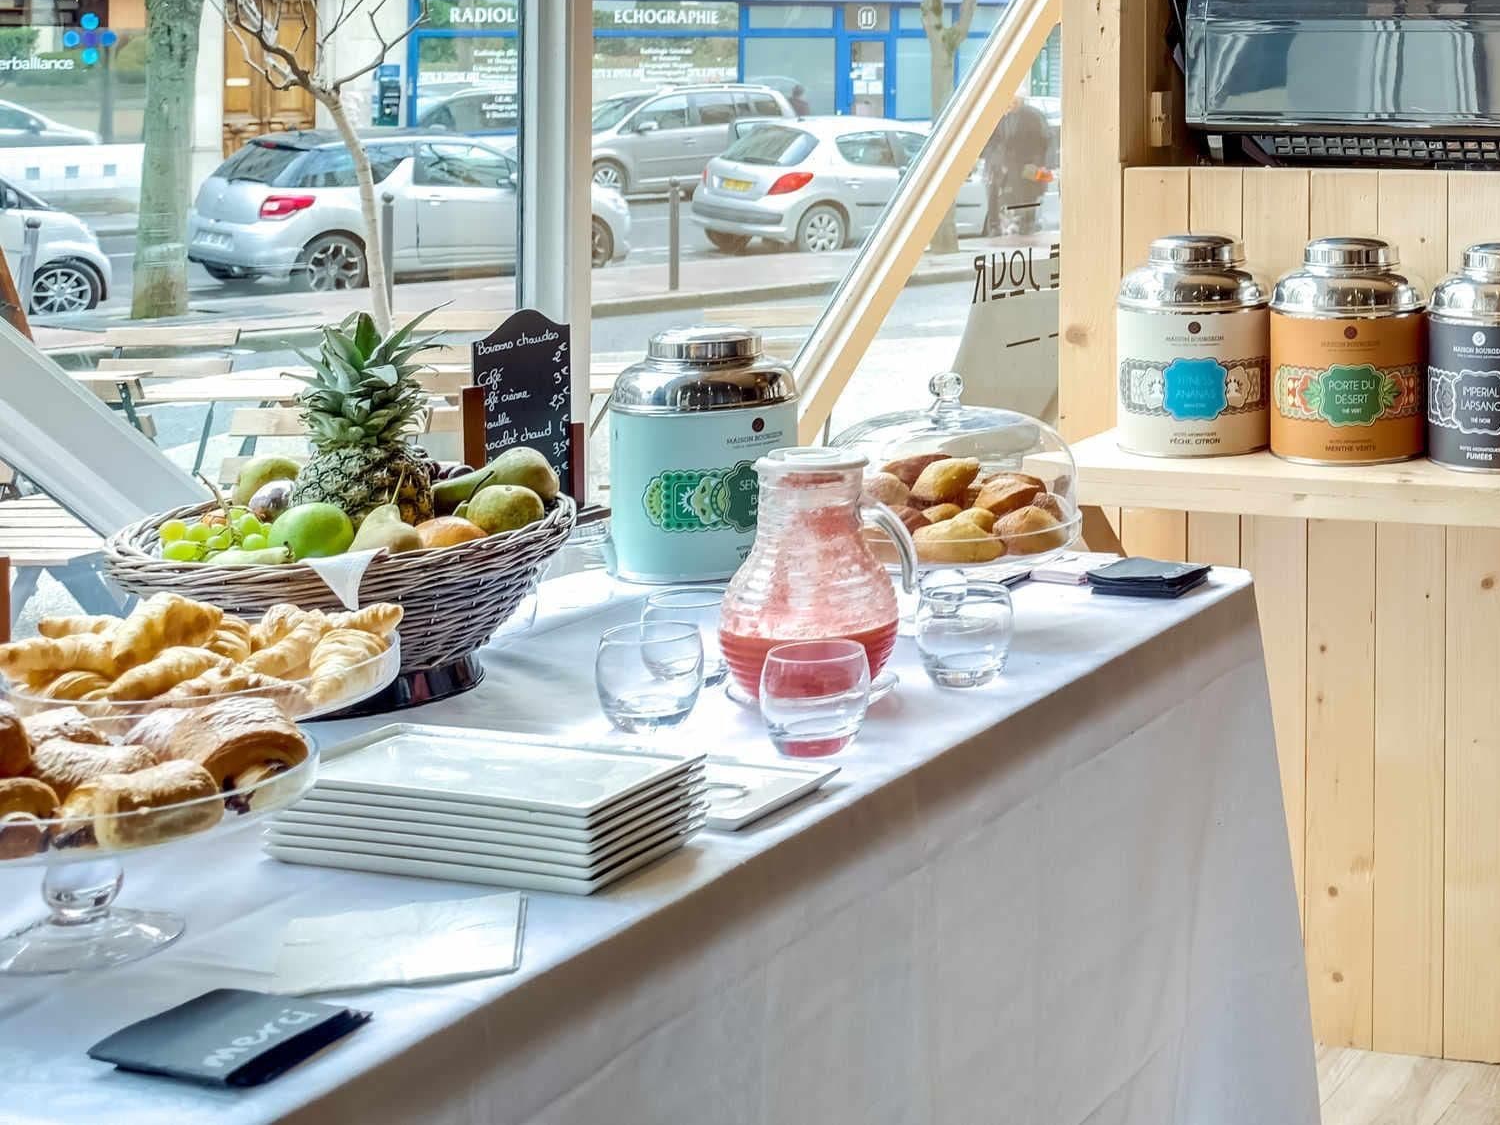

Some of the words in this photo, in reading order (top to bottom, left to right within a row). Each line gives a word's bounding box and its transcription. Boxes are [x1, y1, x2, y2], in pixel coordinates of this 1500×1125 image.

[451, 6, 518, 24] RADIOL
[614, 7, 720, 25] ECHOGRAPHIE
[0, 57, 74, 70] erballiance
[1329, 379, 1360, 390] PORTE
[1361, 378, 1375, 390] DU
